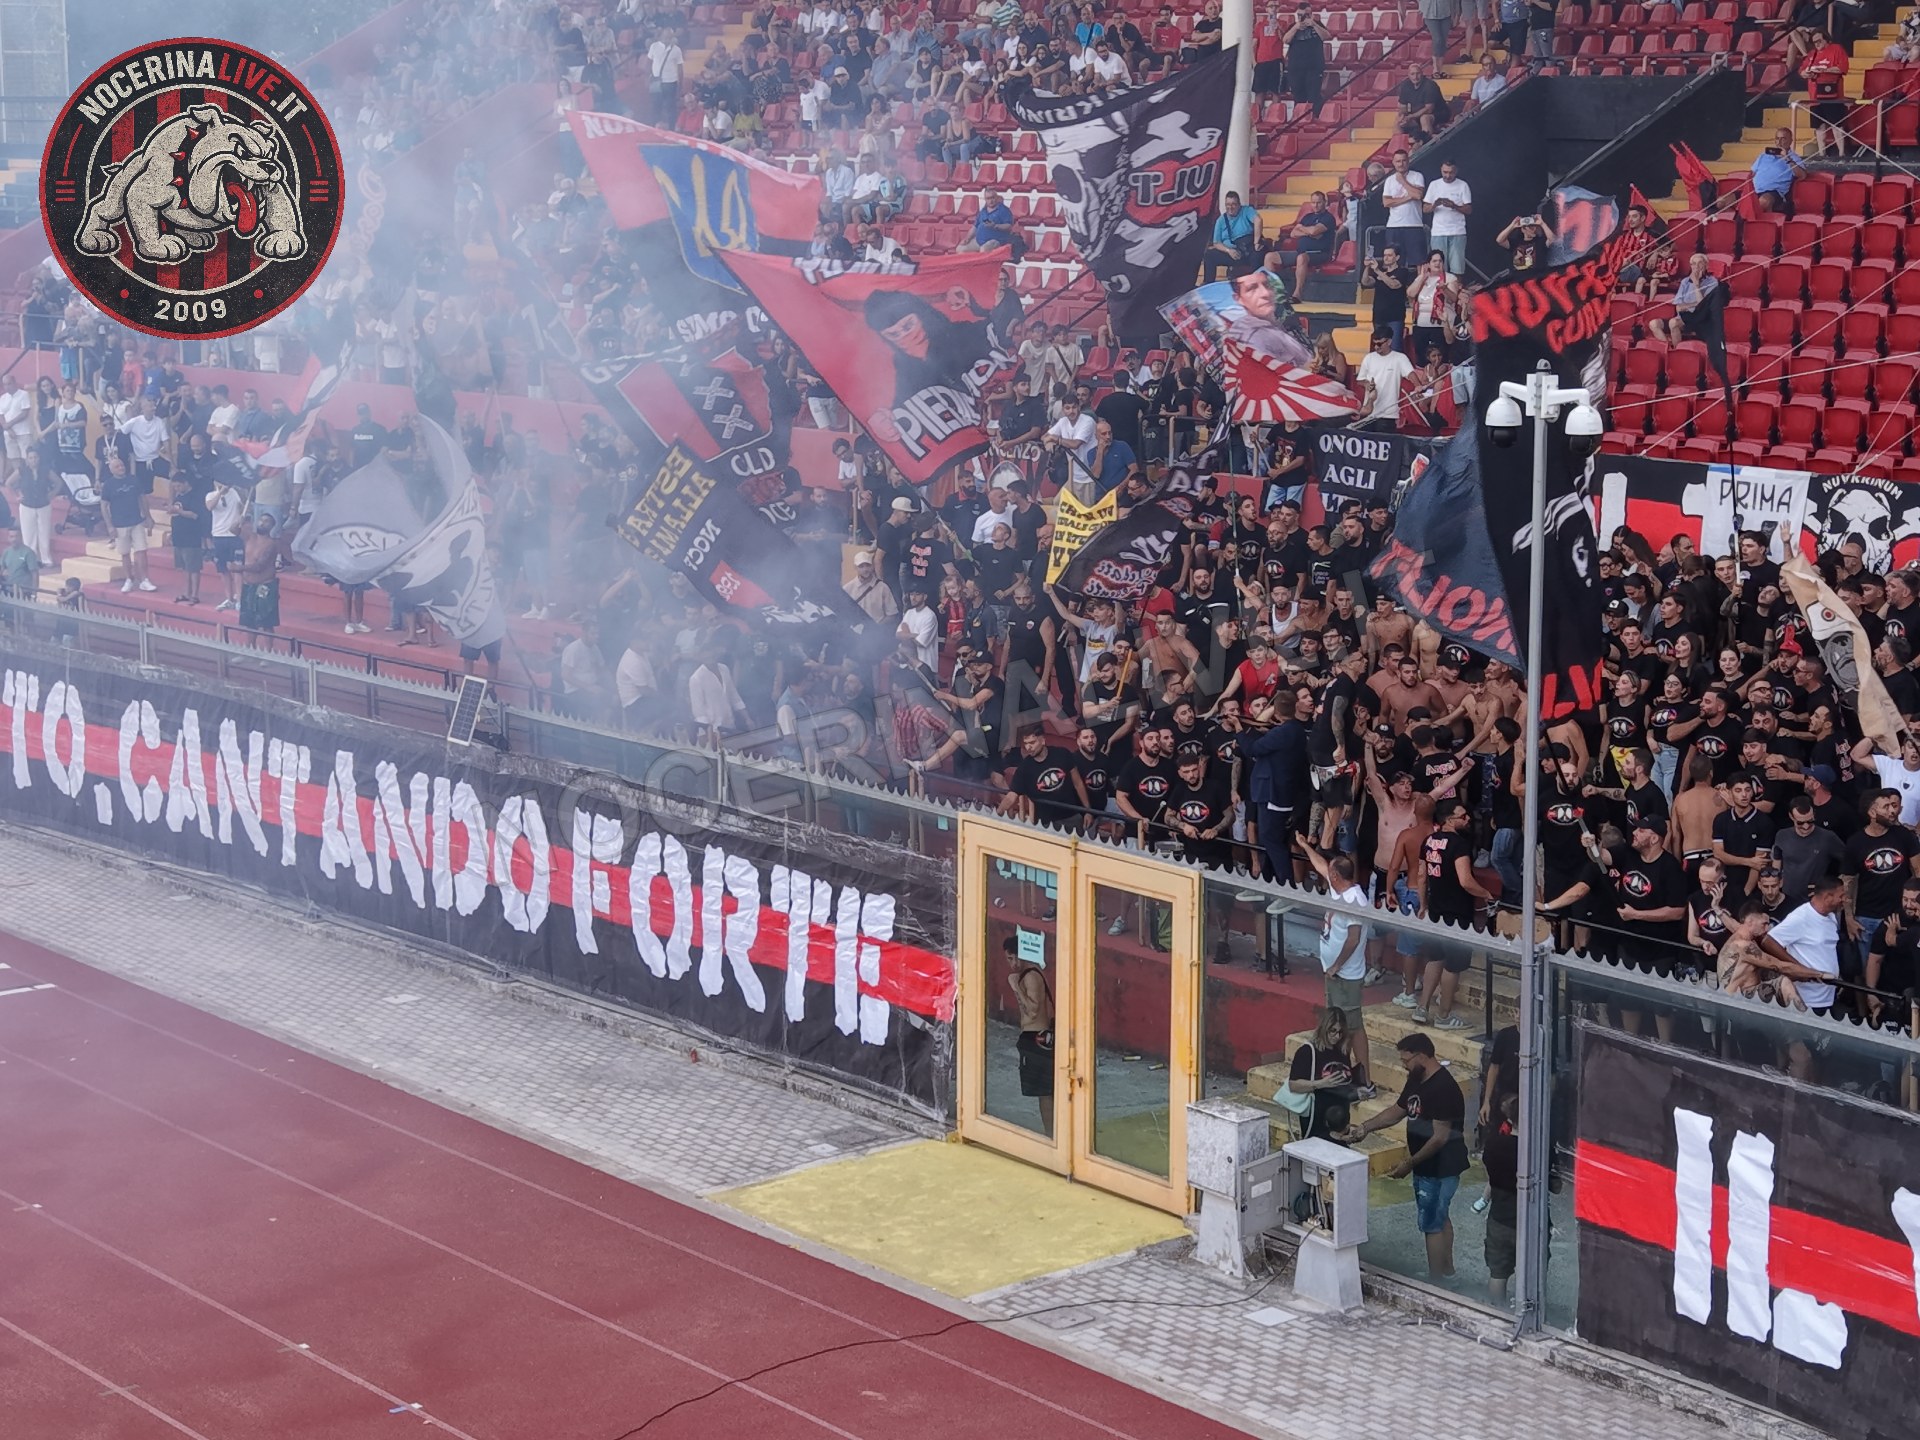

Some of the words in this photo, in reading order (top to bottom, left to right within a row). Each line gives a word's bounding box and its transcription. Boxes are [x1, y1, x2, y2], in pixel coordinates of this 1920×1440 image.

[1319, 434, 1392, 461] ONORE
[1323, 463, 1378, 490] AGLI
[1719, 478, 1793, 514] PRIMA
[118, 699, 551, 935] CANTANDO
[571, 805, 898, 1046] FORTE
[1673, 1106, 1848, 1370] IL
